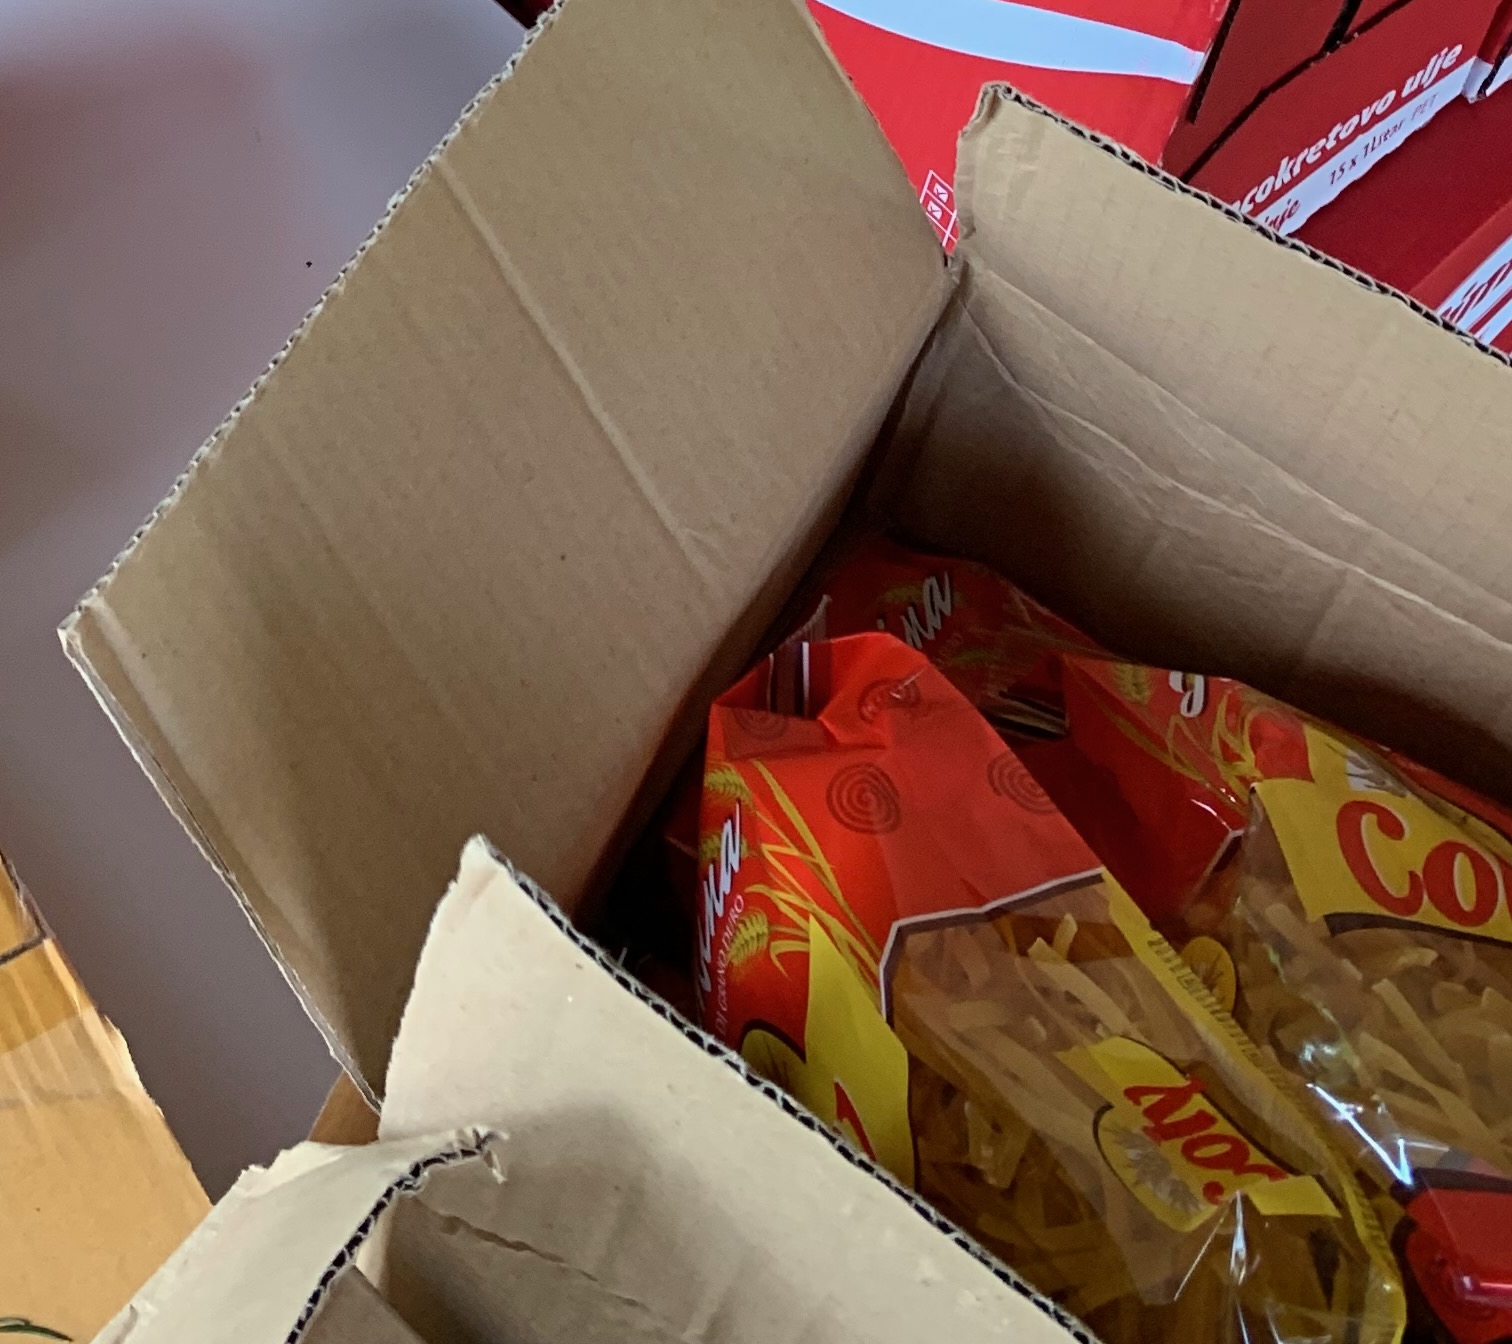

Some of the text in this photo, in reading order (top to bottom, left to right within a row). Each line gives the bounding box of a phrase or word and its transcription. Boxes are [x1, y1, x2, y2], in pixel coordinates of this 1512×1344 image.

[1403, 44, 1463, 99] ulje
[1329, 166, 1345, 187] 15
[728, 893, 745, 944] DURO
